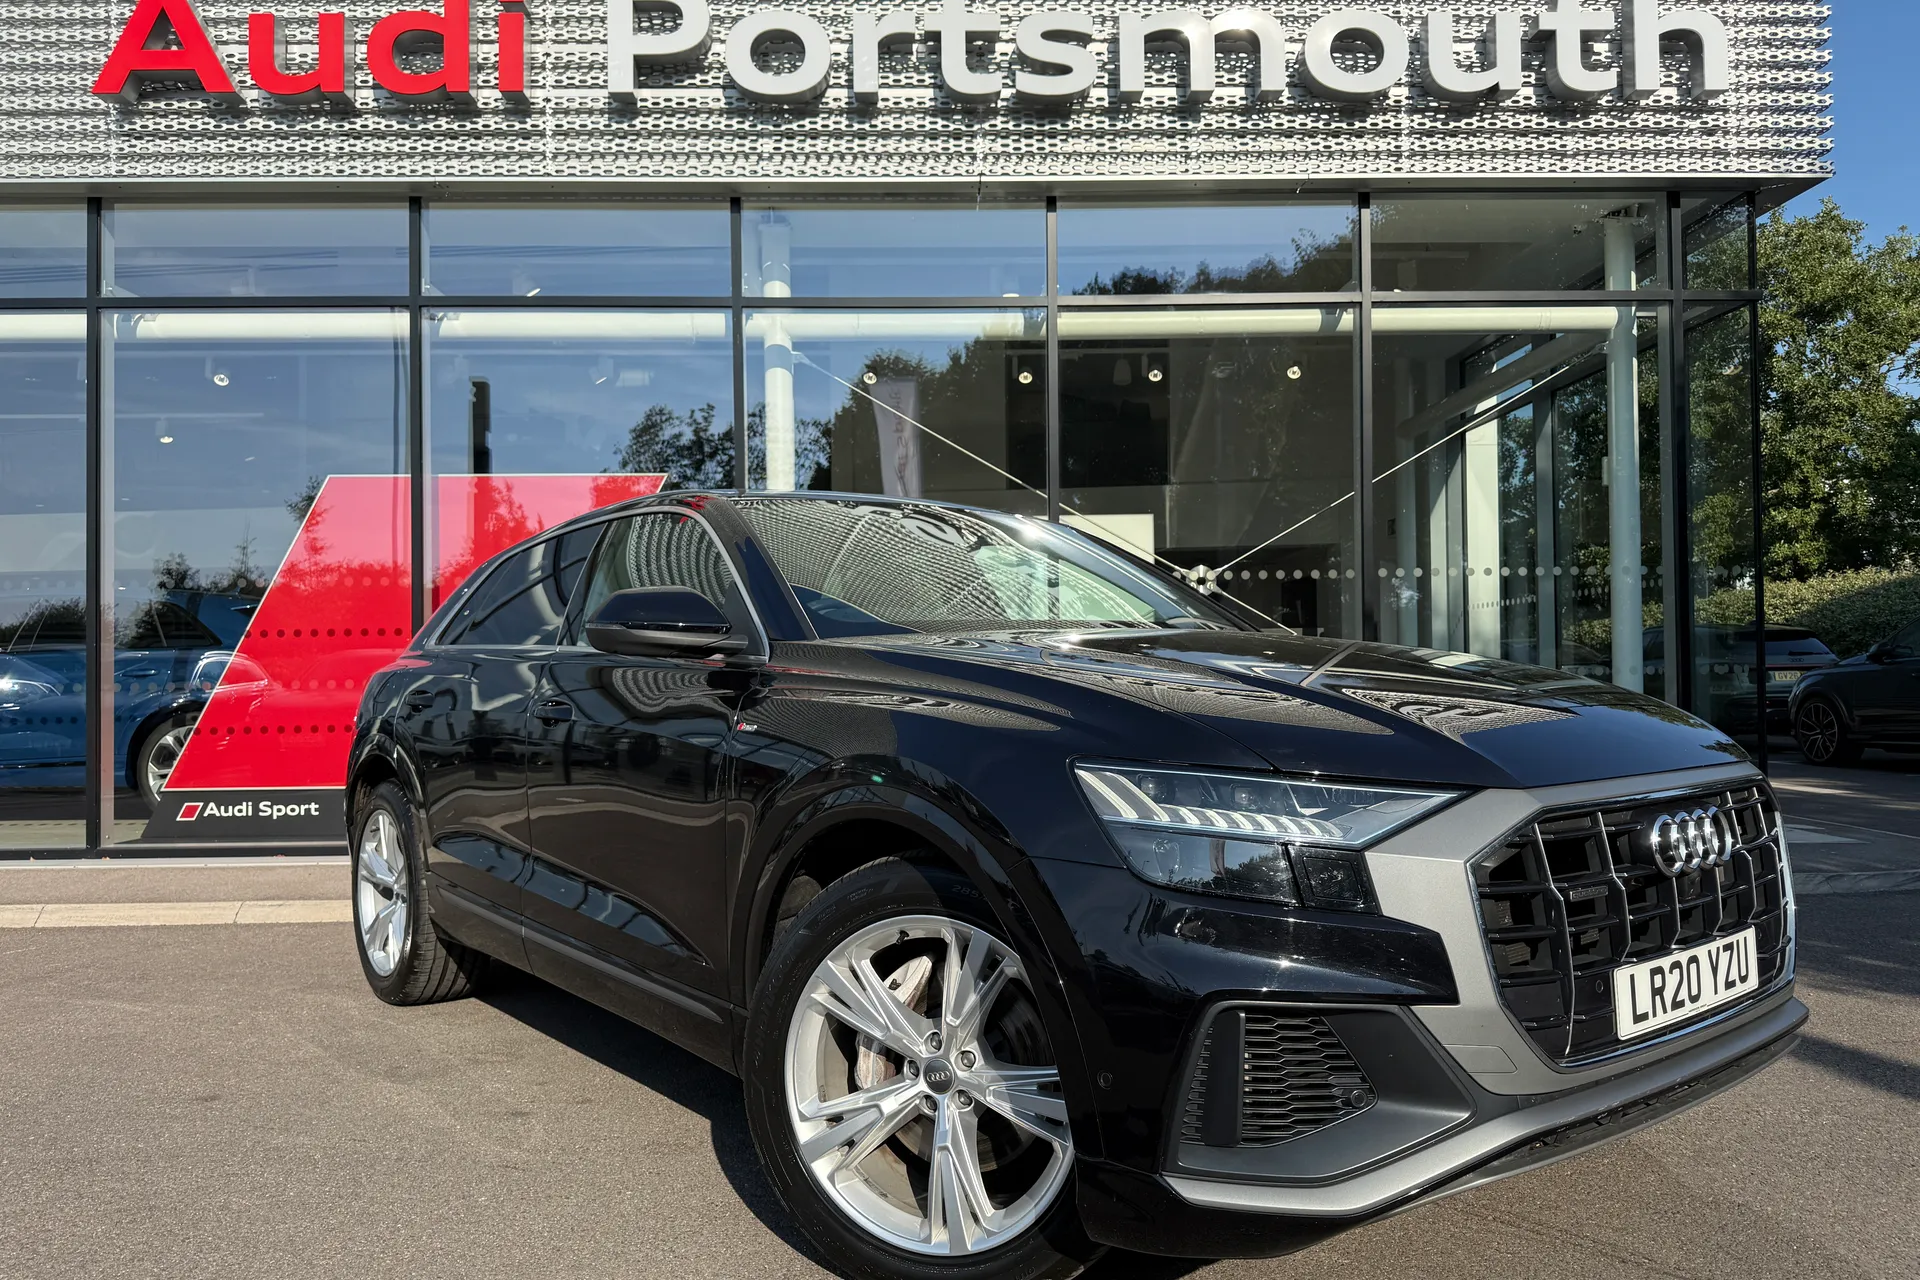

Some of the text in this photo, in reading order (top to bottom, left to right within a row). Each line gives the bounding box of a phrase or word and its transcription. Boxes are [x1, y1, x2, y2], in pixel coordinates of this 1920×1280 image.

[91, 0, 1729, 97] Audi Portsmouth
[203, 801, 320, 820] Audi Sport
[1629, 936, 1750, 1025] LR20 YZU
